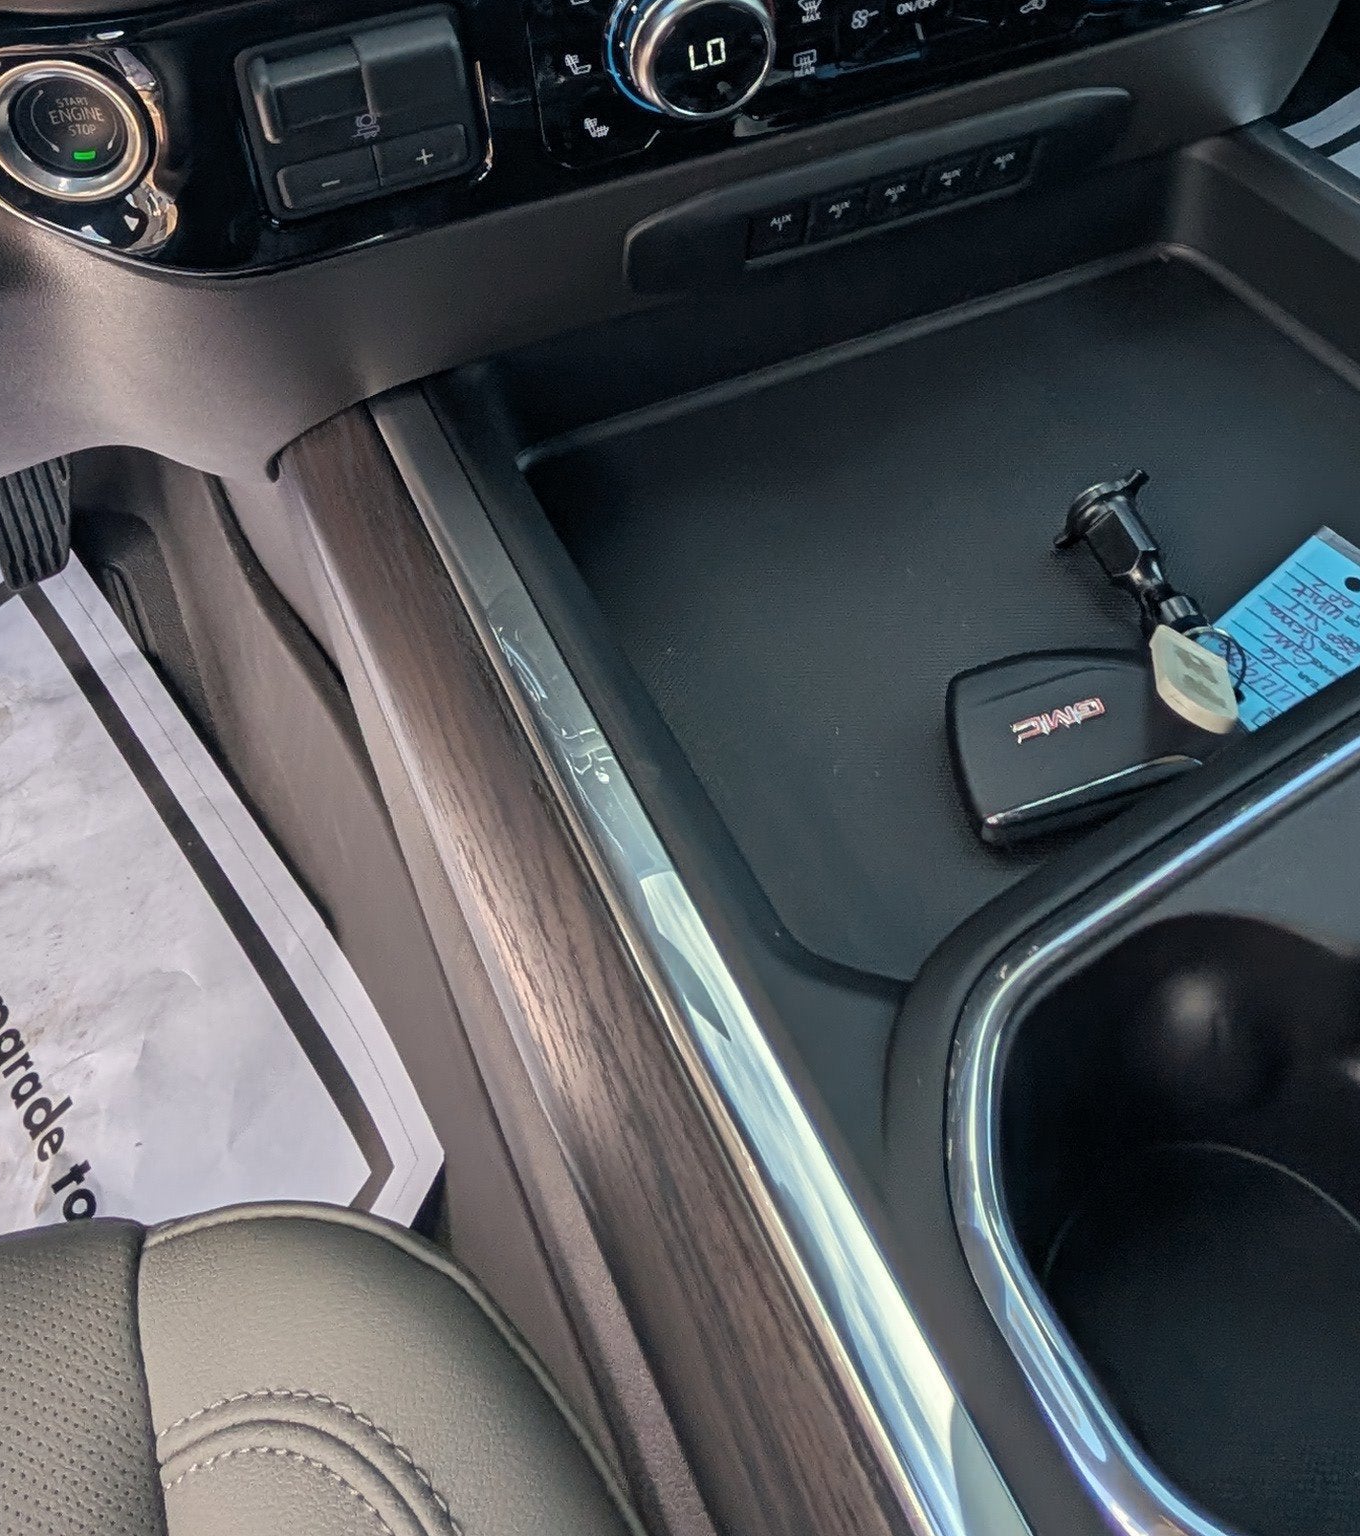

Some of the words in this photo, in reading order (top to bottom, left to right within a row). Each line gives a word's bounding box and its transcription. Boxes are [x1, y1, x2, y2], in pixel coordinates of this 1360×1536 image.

[801, 12, 822, 24] MAX
[688, 37, 727, 71] LO
[794, 66, 816, 78] REAR
[55, 97, 88, 108] START
[48, 106, 105, 125] ENGINE
[68, 124, 96, 137] STOP
[1009, 697, 1107, 744] GMC
[51, 1160, 97, 1223] to
